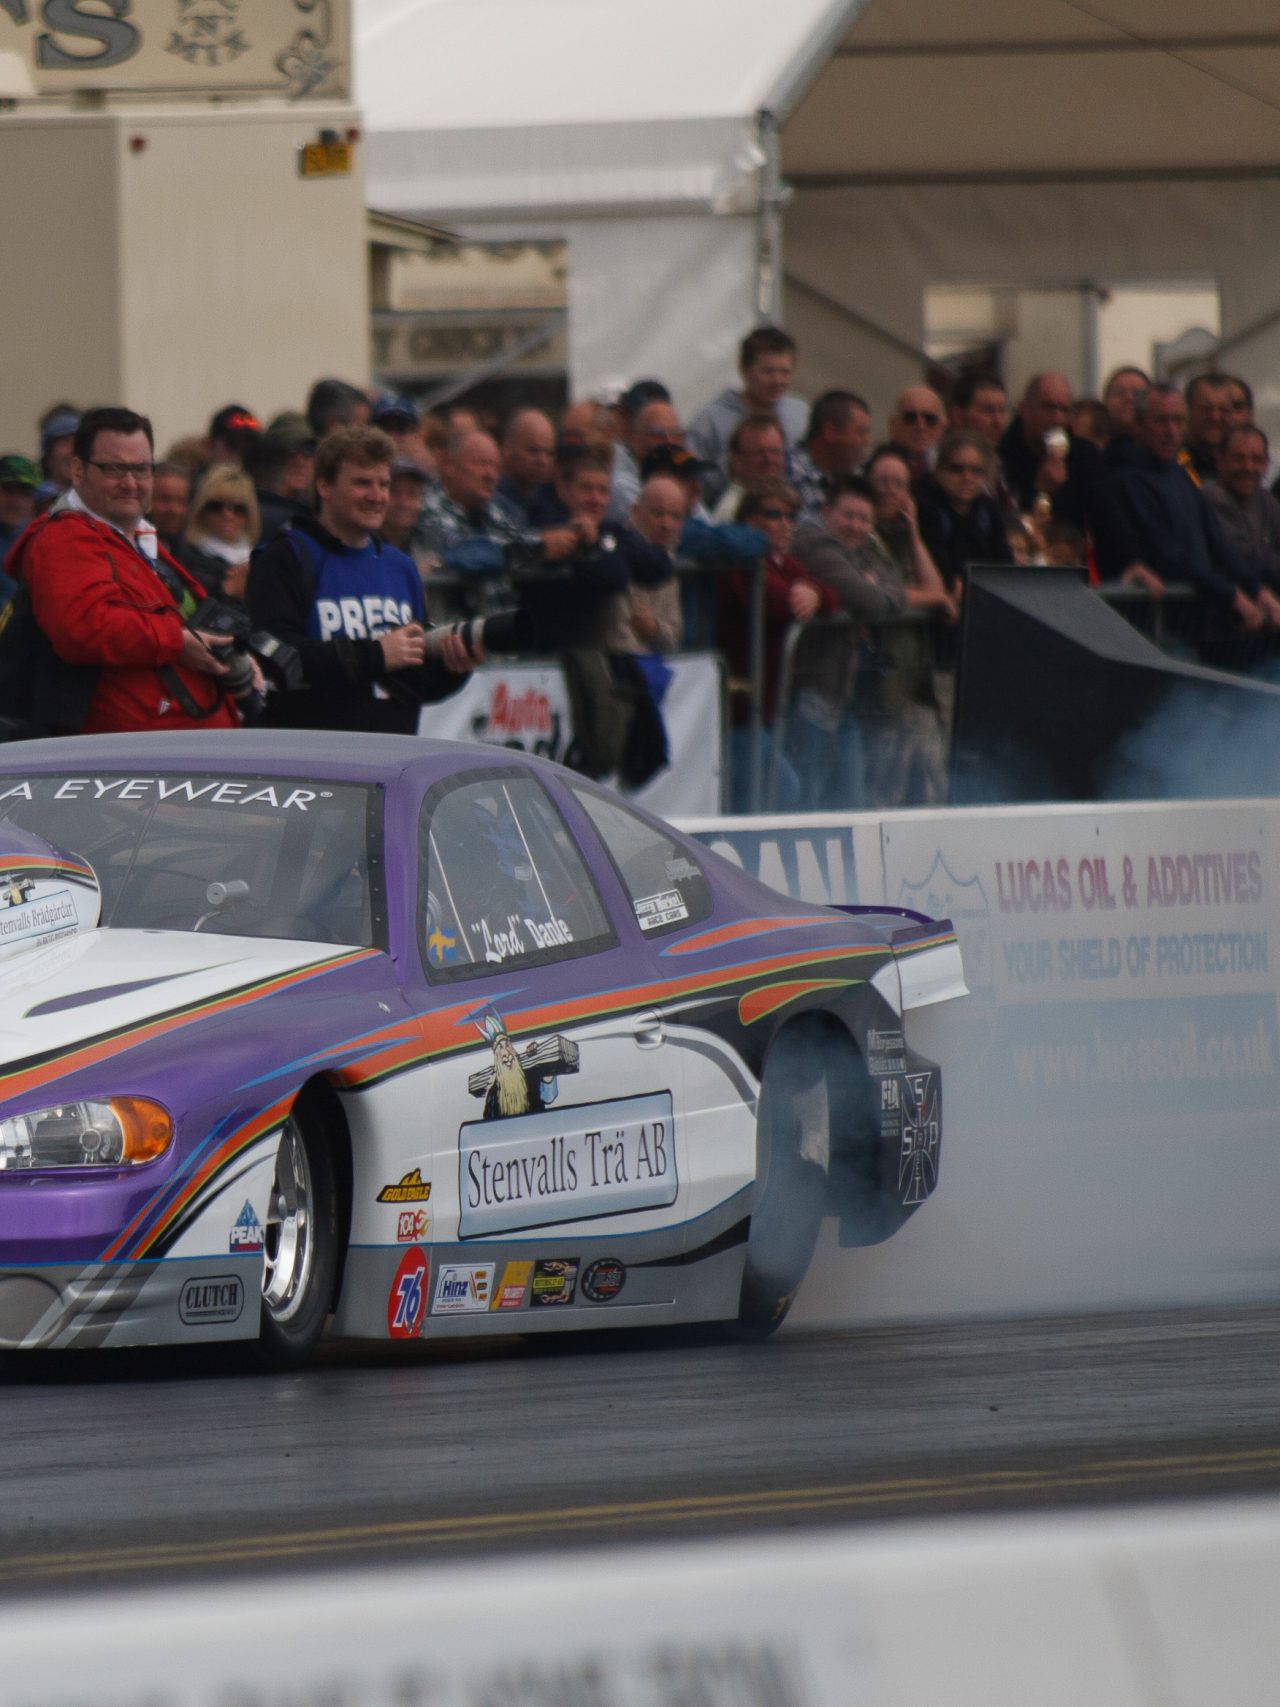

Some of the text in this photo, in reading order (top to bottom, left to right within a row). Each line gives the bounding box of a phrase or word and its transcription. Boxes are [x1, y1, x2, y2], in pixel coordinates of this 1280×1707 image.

[490, 682, 552, 733] Auto
[994, 850, 1263, 914] LUCAS OIL & ADDITIVES
[1003, 930, 1268, 983] YOUR SHIELD OF PROTECTION
[468, 1122, 668, 1208] Stenvalls Trä AB
[186, 1283, 238, 1309] CLUTCH
[392, 1267, 424, 1333] 76
[443, 1280, 469, 1297] Hinz
